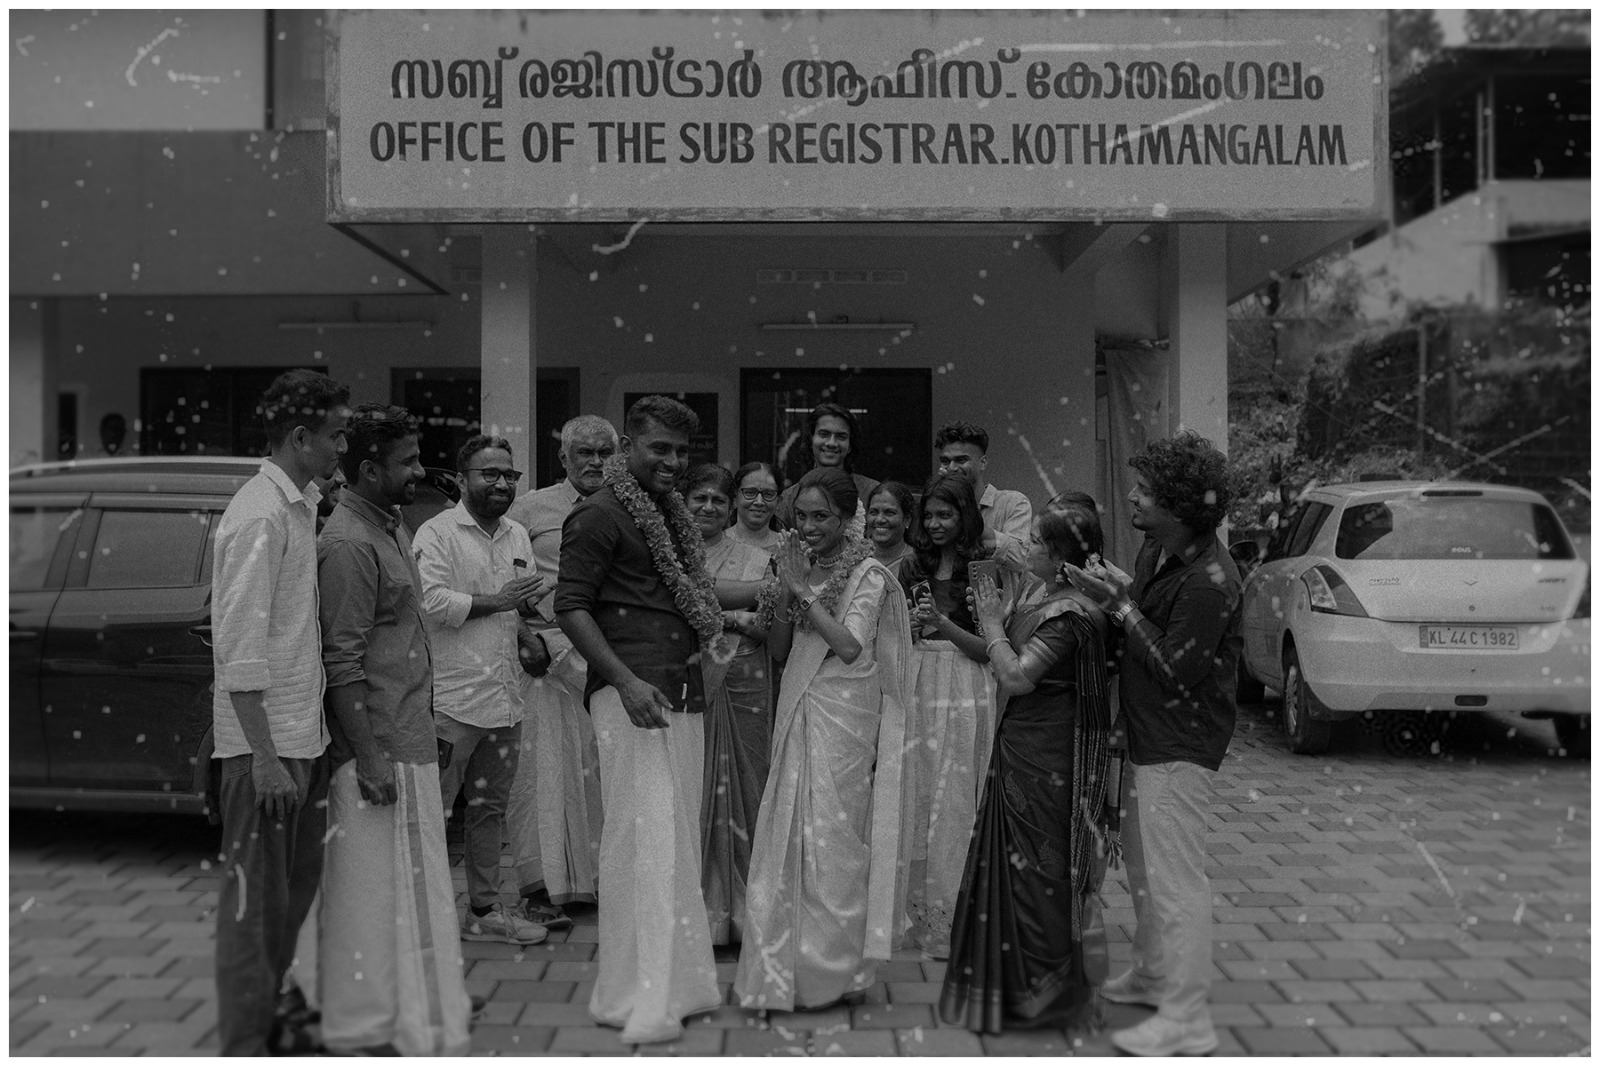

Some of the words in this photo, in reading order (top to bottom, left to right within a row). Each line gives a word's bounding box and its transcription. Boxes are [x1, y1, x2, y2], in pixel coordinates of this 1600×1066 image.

[370, 121, 505, 163] OFFICE
[521, 121, 576, 164] OF
[587, 121, 667, 164] THE
[678, 121, 755, 165] SUB
[1429, 629, 1446, 645] KL
[1450, 631, 1467, 645] 44
[1470, 631, 1477, 645] C
[1482, 631, 1516, 646] 1982
